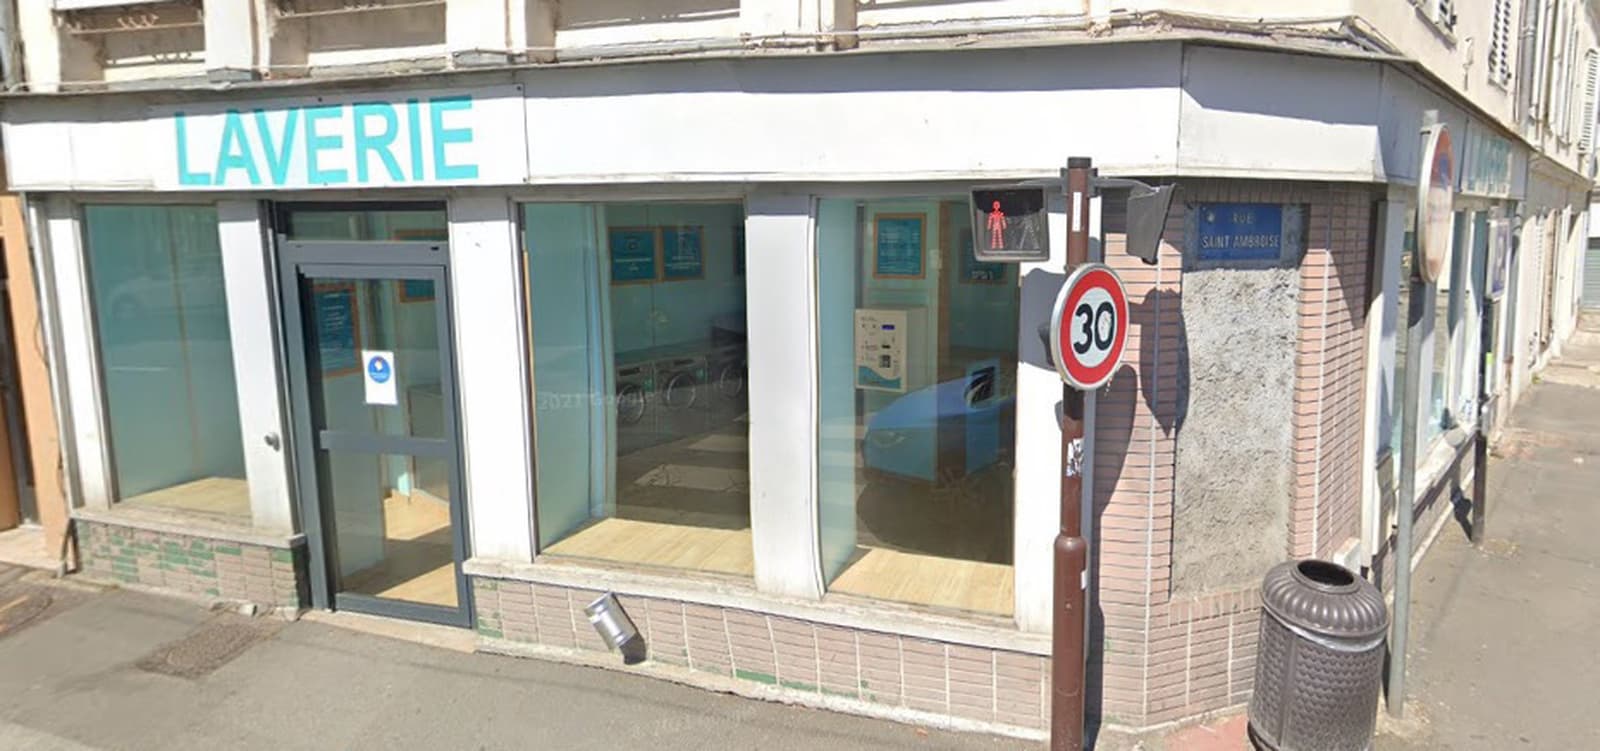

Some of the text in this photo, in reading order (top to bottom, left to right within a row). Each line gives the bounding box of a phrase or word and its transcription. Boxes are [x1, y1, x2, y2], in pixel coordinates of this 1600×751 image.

[175, 96, 479, 186] LAVERIE
[1232, 211, 1254, 225] RUE
[1201, 234, 1280, 249] SAINT AMBROISE
[1074, 303, 1115, 355] 30
